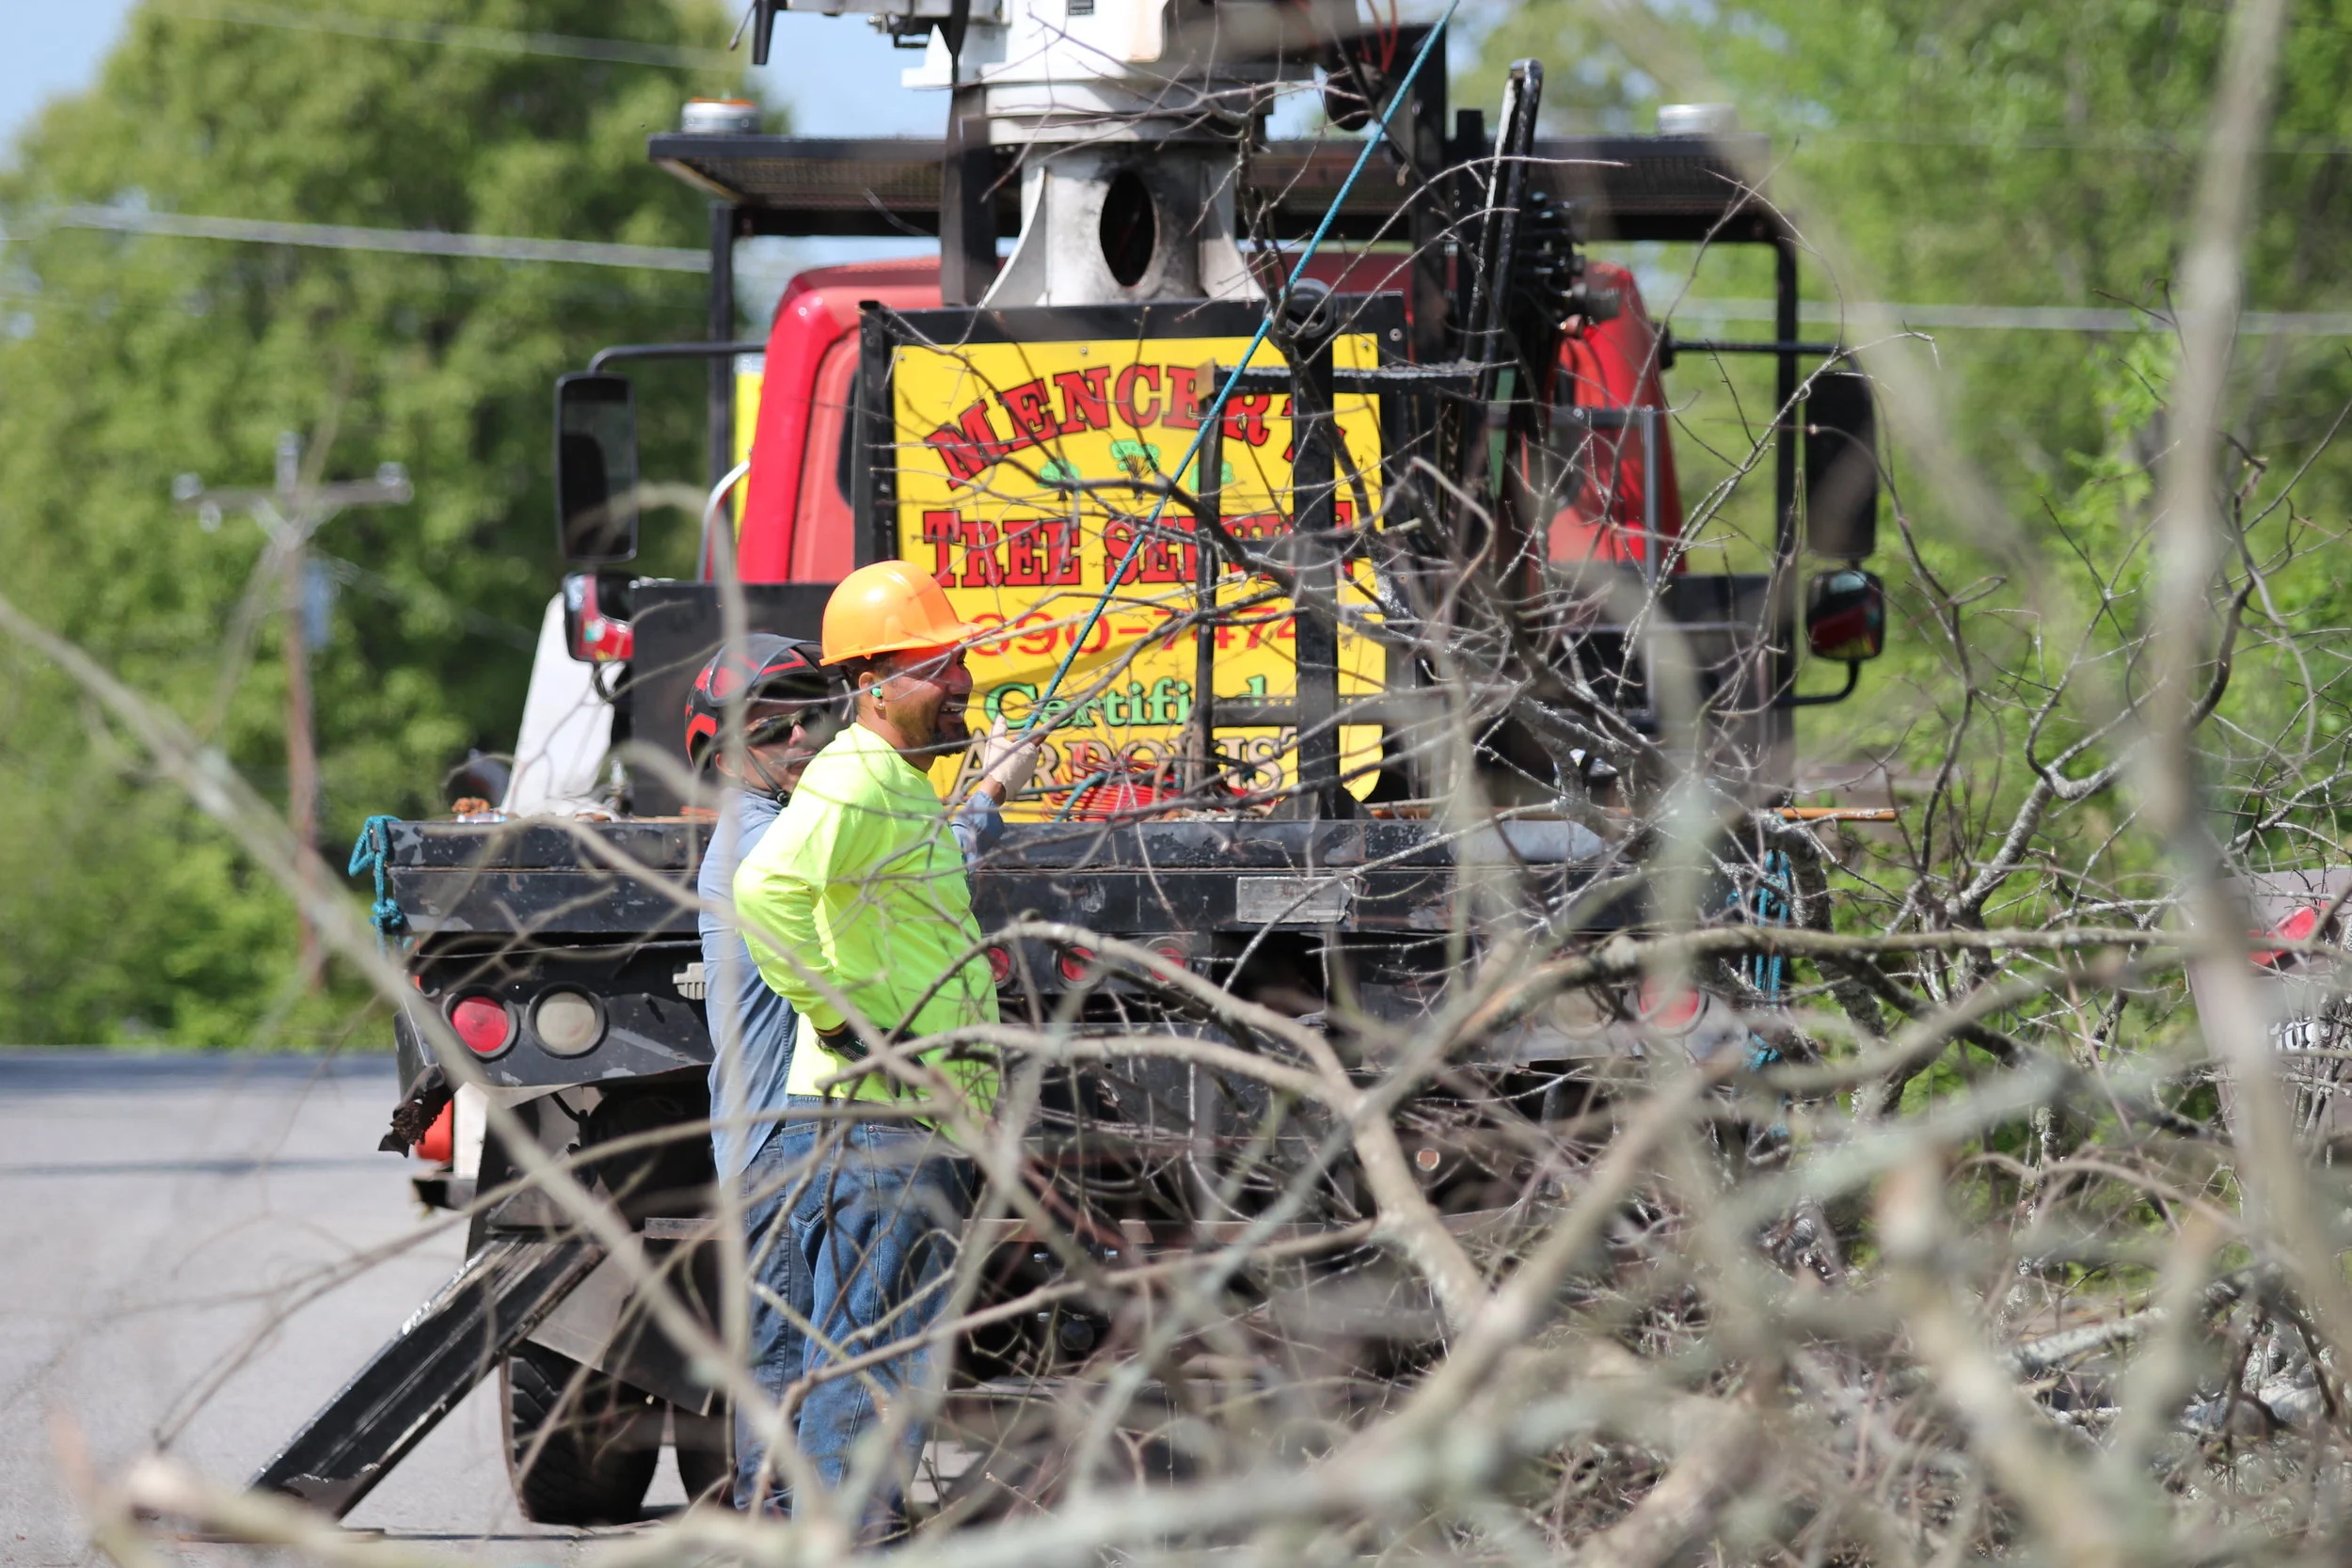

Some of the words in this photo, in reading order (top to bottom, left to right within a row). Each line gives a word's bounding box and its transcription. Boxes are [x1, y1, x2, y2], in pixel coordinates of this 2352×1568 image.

[924, 364, 1346, 491] MENCER
[923, 509, 1081, 588] TREE
[983, 674, 1266, 729] Certifi
